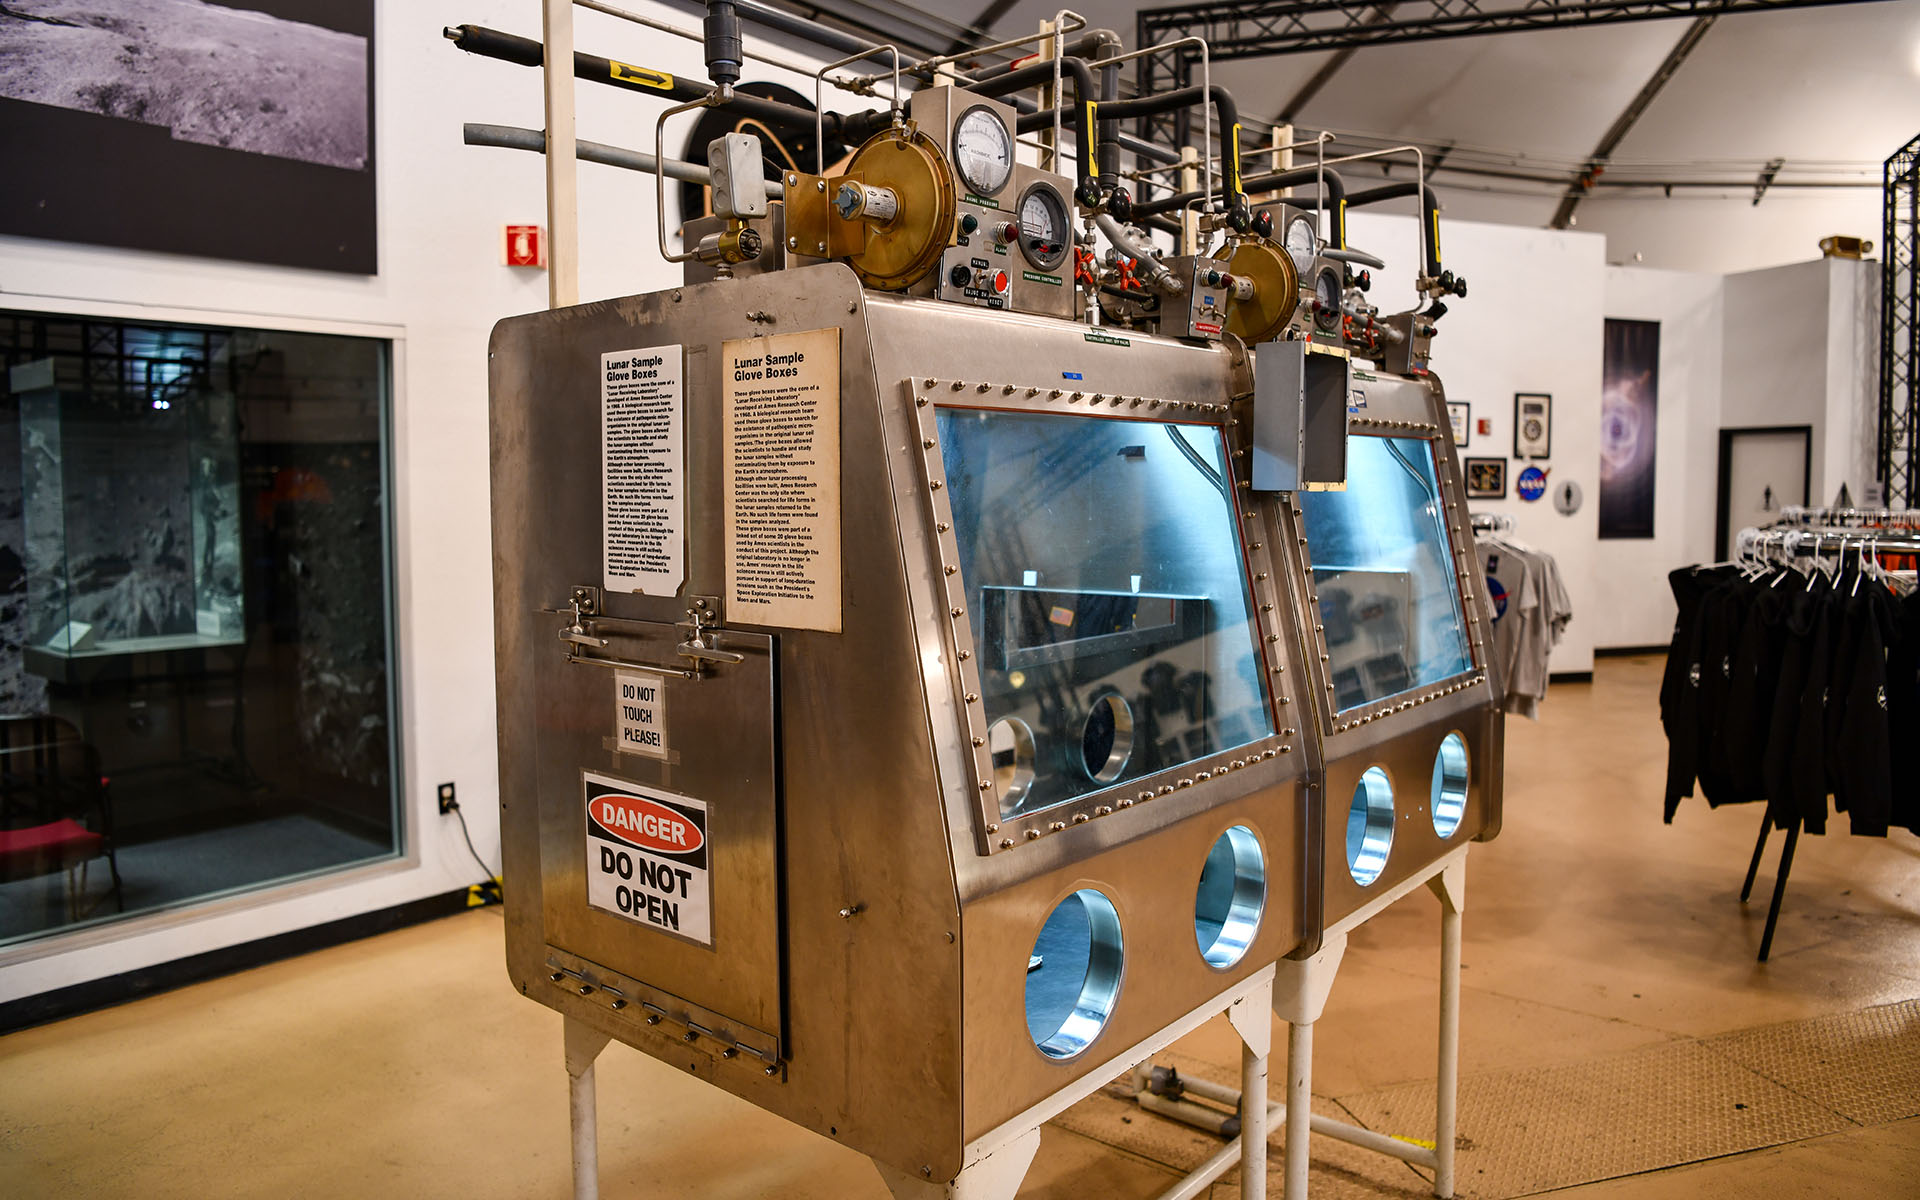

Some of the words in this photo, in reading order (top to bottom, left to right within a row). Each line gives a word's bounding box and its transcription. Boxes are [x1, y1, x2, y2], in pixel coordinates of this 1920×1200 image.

[607, 360, 629, 370] Lunar
[632, 356, 663, 368] Sample
[735, 358, 763, 368] Lunar
[766, 352, 804, 366] Sample
[607, 371, 629, 381] Glove
[632, 369, 657, 379] Boxes
[735, 371, 762, 381] Glove
[766, 367, 798, 378] Boxes
[623, 684, 634, 699] DO
[637, 686, 655, 702] NOT
[623, 706, 652, 724] TOUCH
[625, 728, 660, 746] PLEASE!
[603, 802, 686, 847] DANGER
[600, 845, 633, 880] DO
[640, 858, 691, 899] NOT
[616, 885, 679, 931] OPEN
